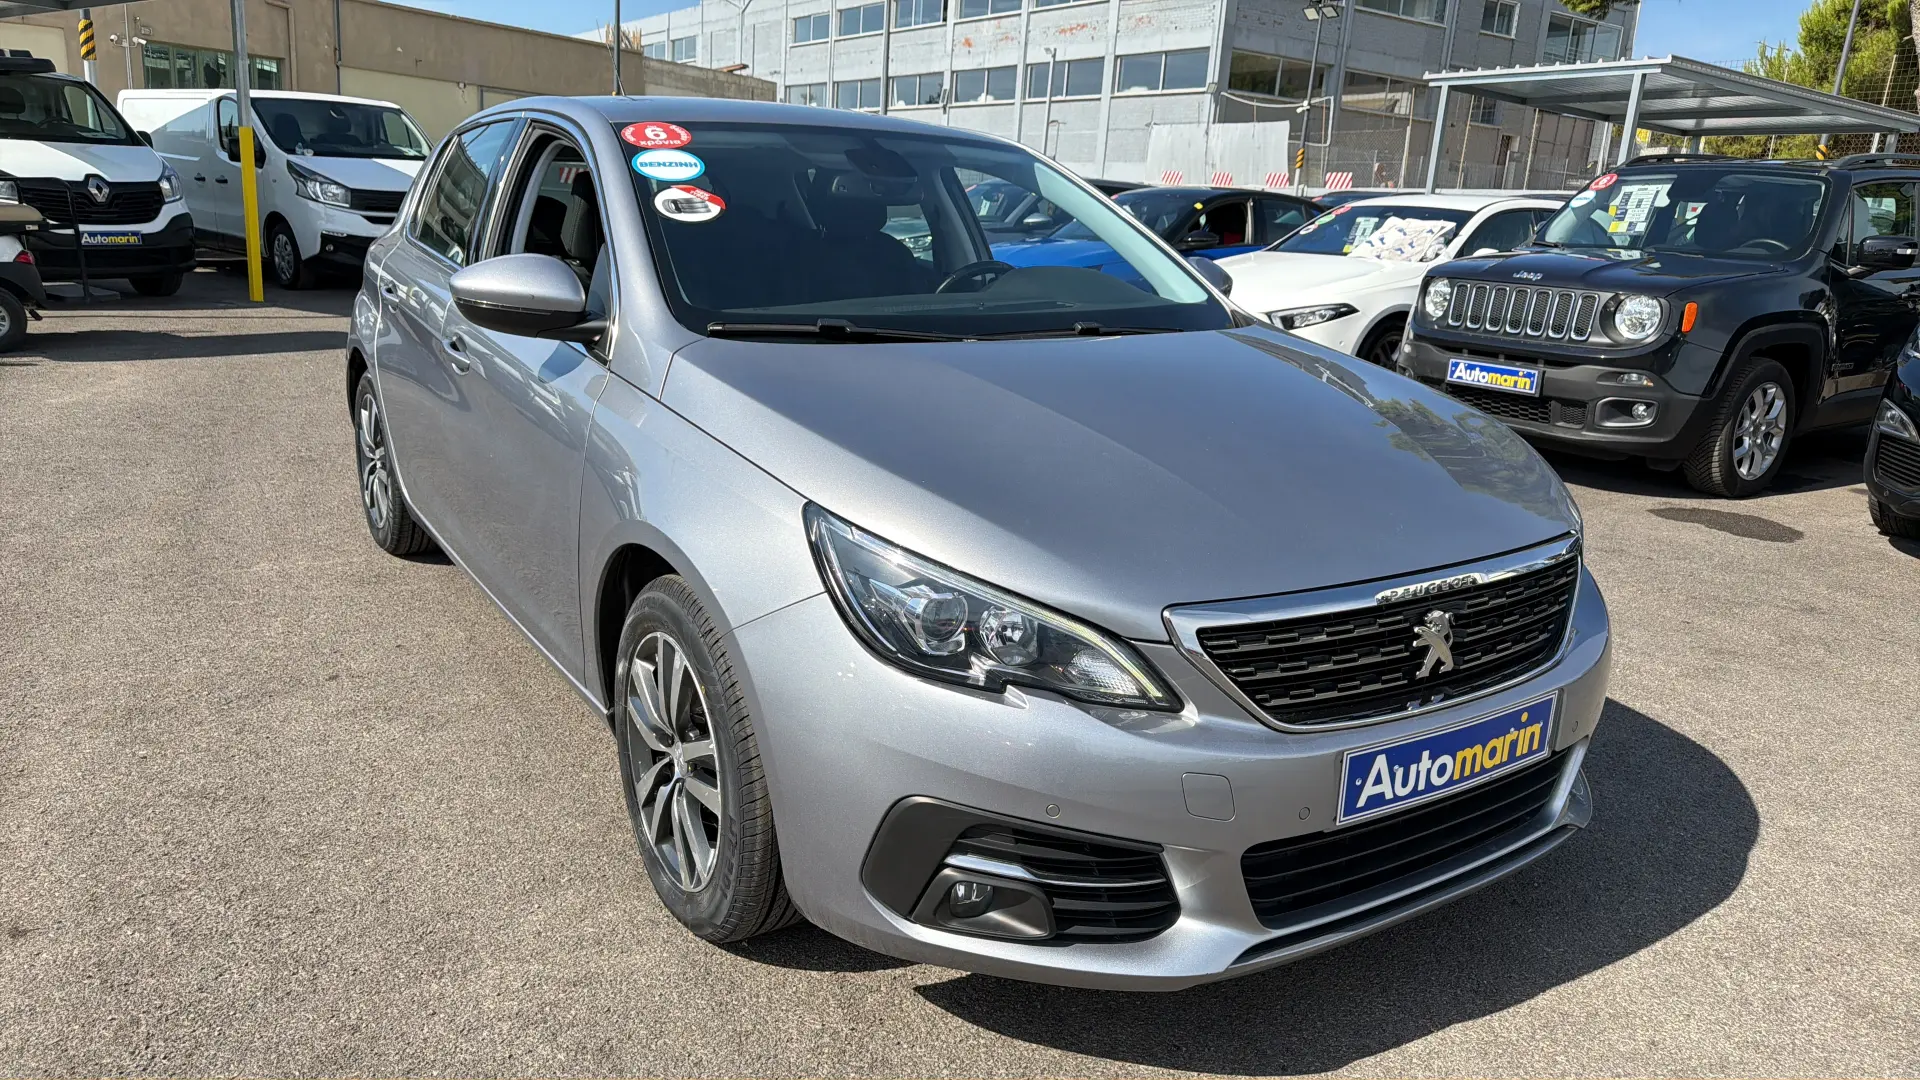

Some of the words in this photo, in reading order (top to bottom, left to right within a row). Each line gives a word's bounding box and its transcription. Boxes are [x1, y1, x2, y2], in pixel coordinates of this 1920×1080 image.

[644, 126, 667, 140] 6
[81, 232, 139, 244] Automarin
[1513, 270, 1543, 281] Jeep
[1452, 362, 1531, 390] Automarin
[1389, 575, 1474, 601] PEUGEOT
[1355, 711, 1542, 809] Automarin
